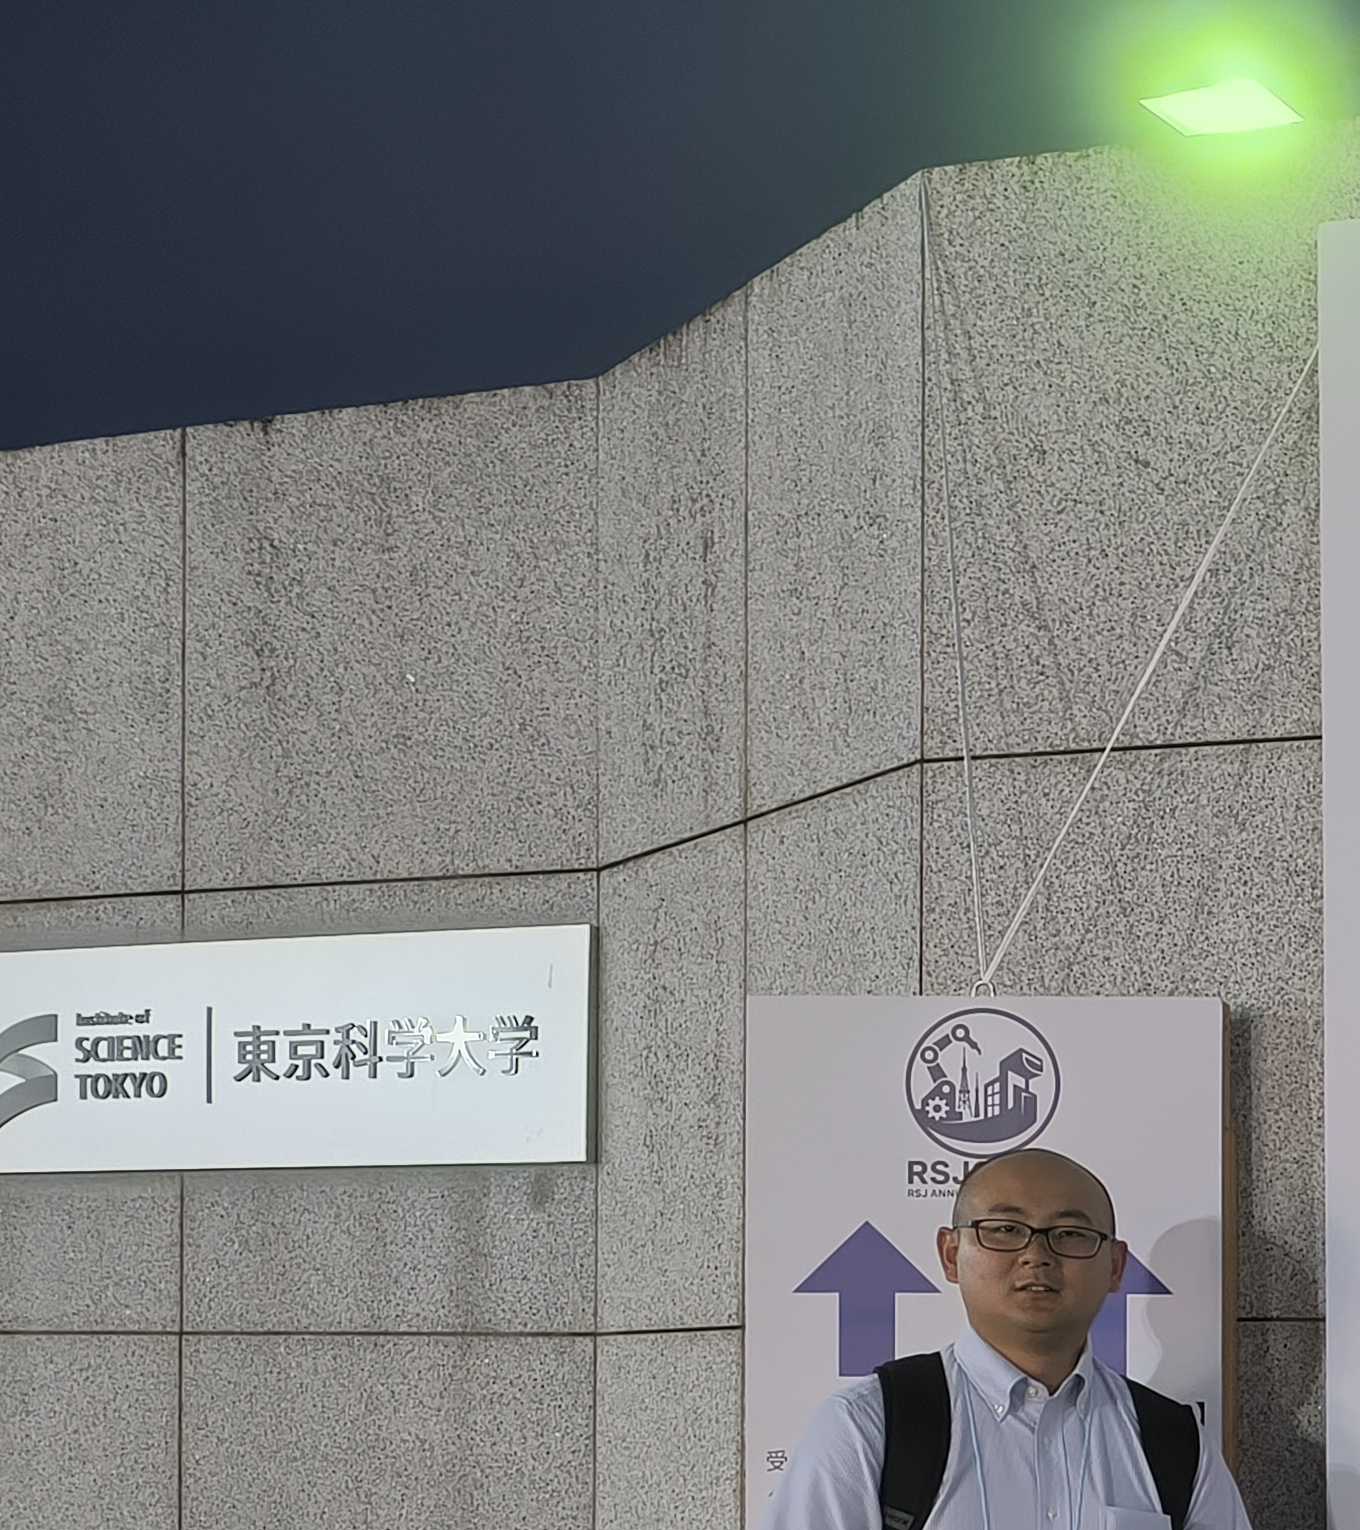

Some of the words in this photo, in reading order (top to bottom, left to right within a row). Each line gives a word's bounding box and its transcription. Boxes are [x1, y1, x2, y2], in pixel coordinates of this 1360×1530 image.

[75, 1034, 183, 1063] SCIENCE
[233, 1015, 539, 1082] 東京科学大学
[74, 1071, 168, 1100] TOKYO
[907, 1160, 971, 1184] RSJ
[907, 1189, 928, 1198] RSJ
[930, 1189, 955, 1198] ANN
